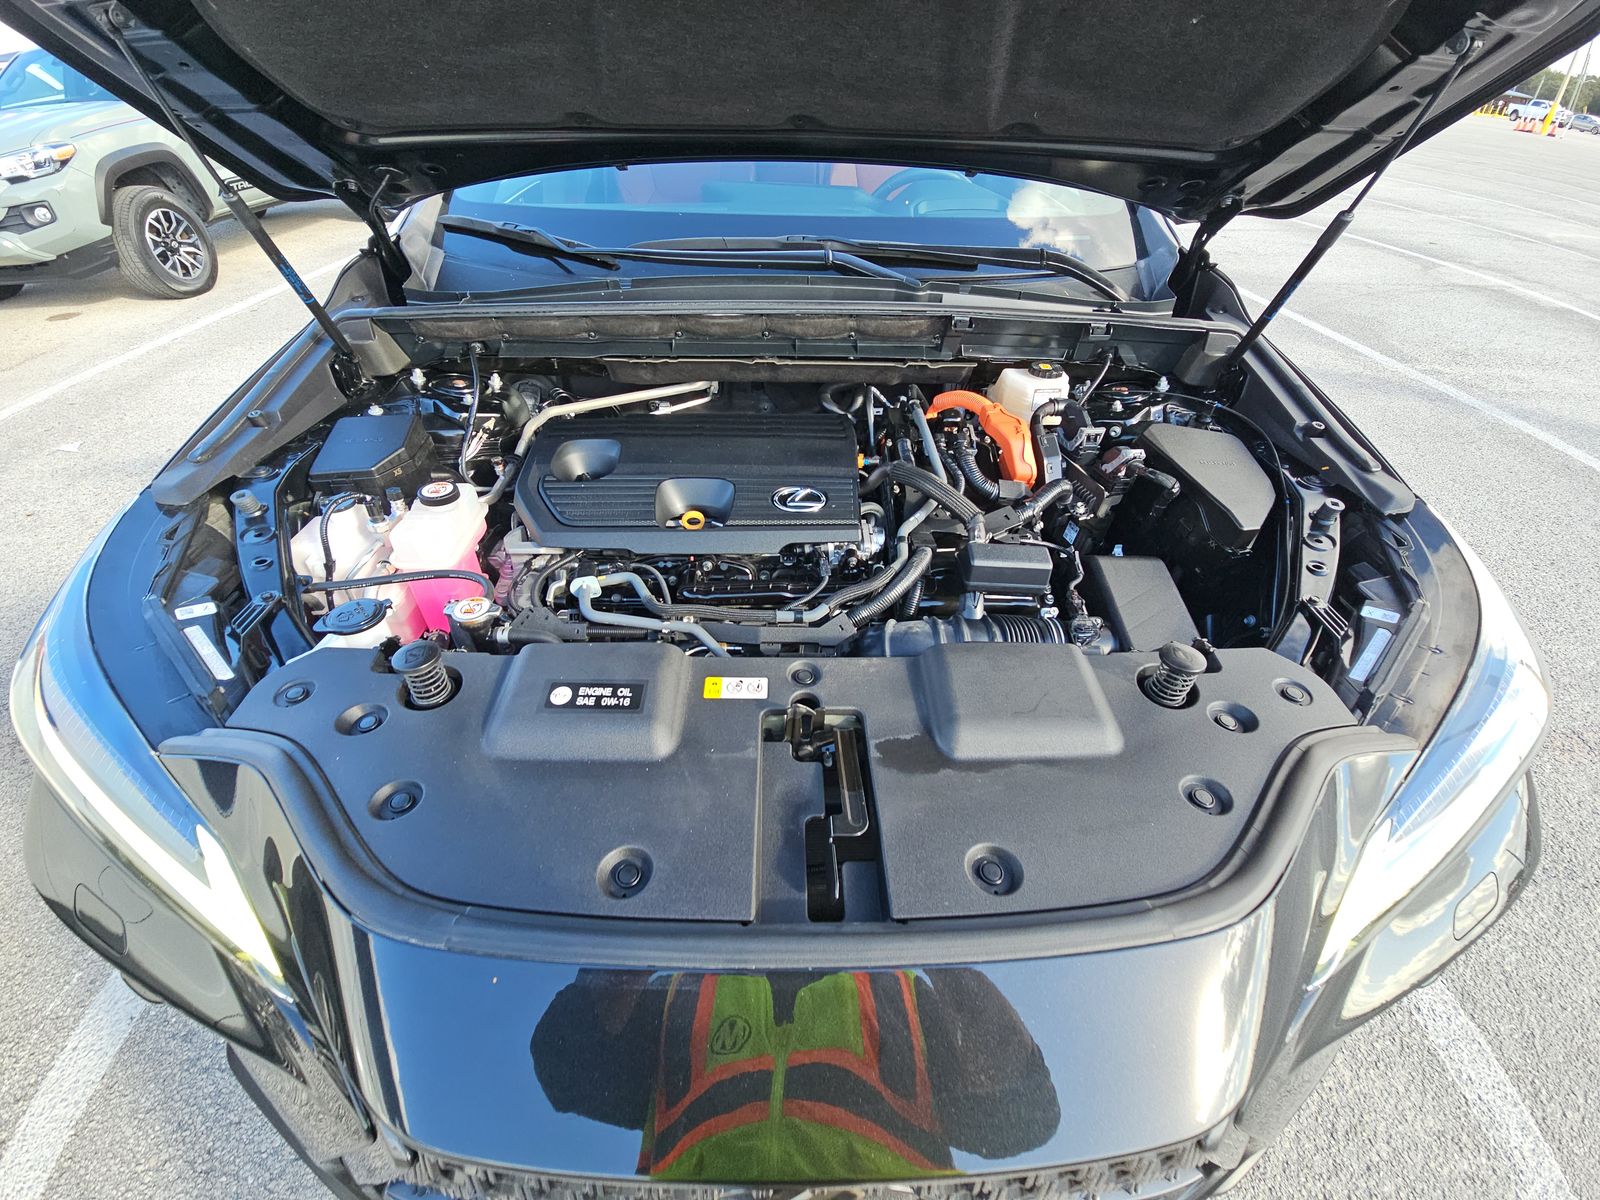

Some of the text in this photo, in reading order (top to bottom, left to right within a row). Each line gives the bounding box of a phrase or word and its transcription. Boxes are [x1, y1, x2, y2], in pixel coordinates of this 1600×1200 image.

[578, 687, 613, 696] ENGINE
[617, 687, 633, 697] OIL
[575, 697, 631, 706] SAE 0W-16
